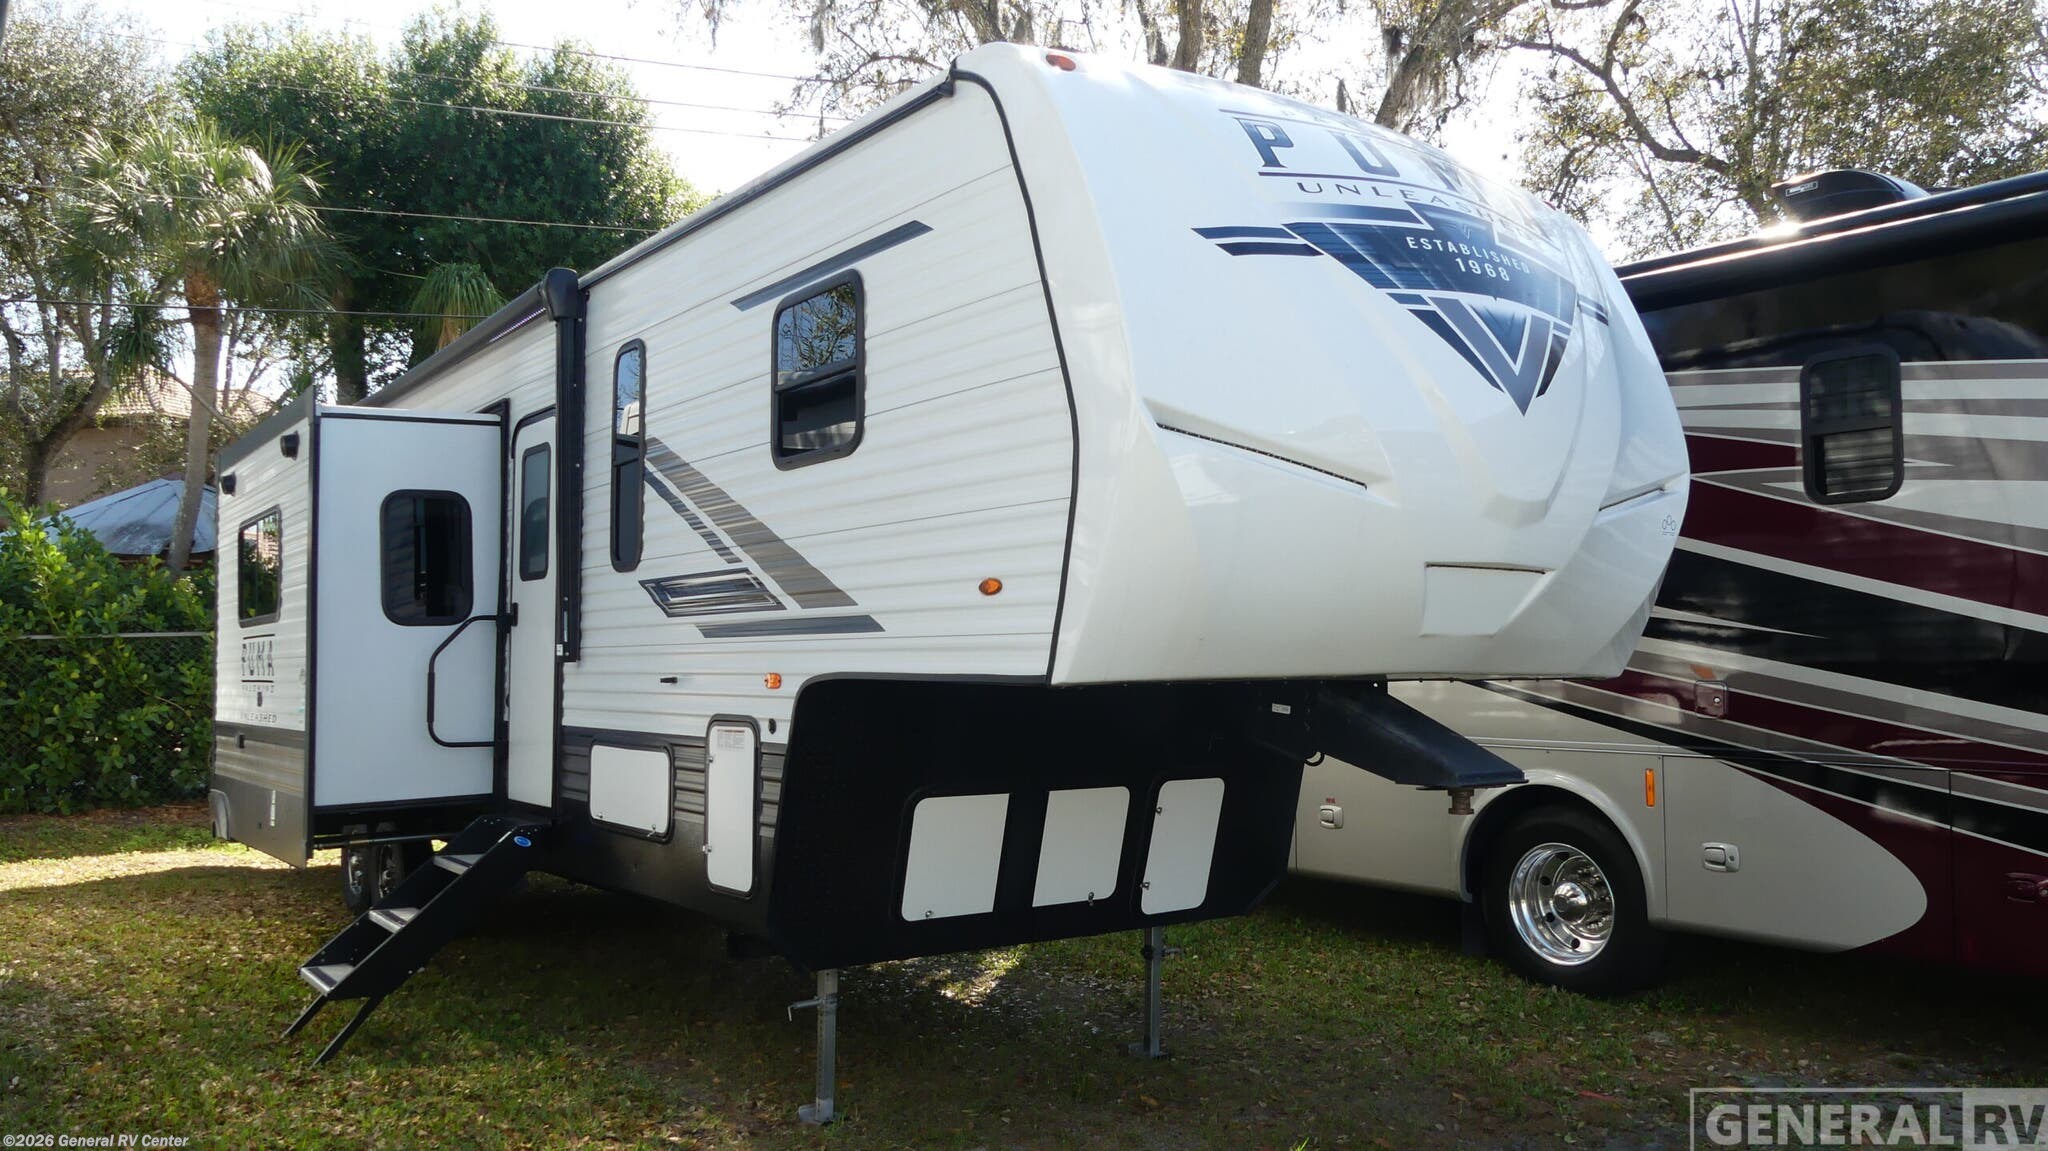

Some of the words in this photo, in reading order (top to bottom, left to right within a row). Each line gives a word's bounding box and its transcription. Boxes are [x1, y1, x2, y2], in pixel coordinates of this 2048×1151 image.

[1405, 236, 1531, 274] ESTABLISHED
[1455, 257, 1510, 281] 1968
[241, 640, 274, 676] PUMA
